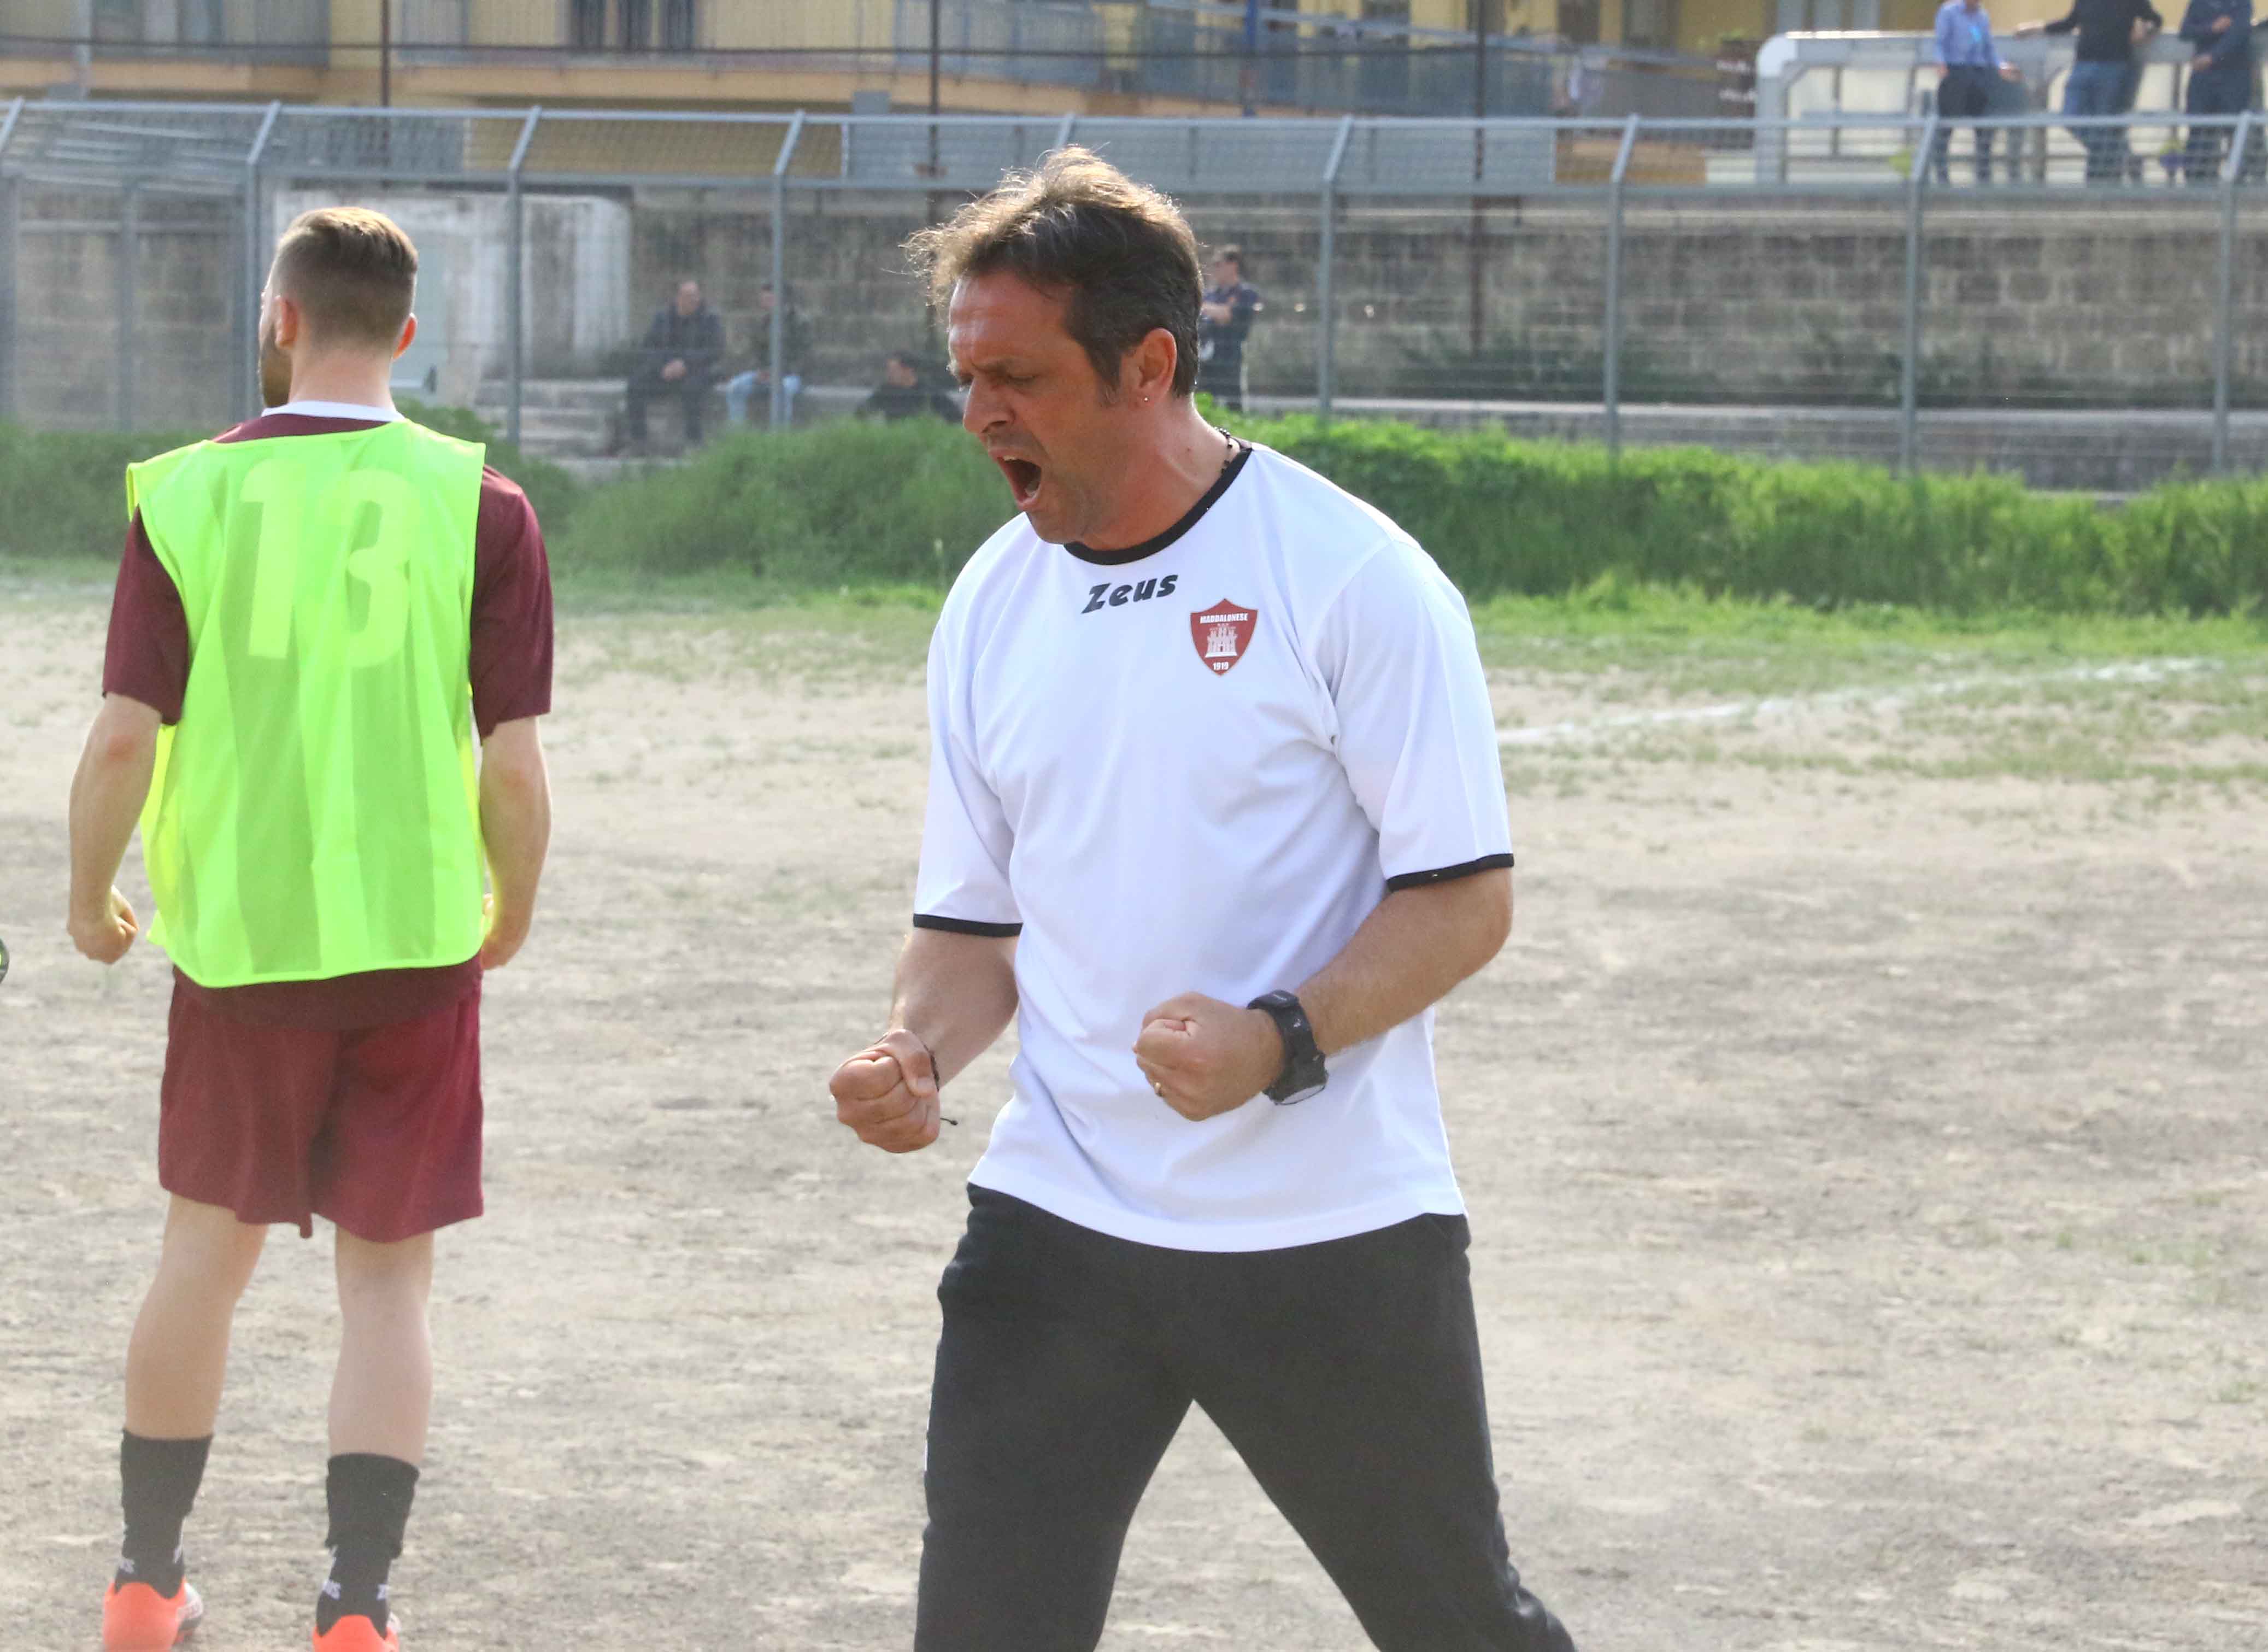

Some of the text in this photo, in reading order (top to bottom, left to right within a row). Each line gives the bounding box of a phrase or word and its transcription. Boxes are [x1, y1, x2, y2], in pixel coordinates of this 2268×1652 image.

[239, 459, 422, 667] 13
[1080, 574, 1178, 613] Zeus
[1200, 612, 1249, 624] MADDALONESE
[1212, 661, 1229, 671] 1919
